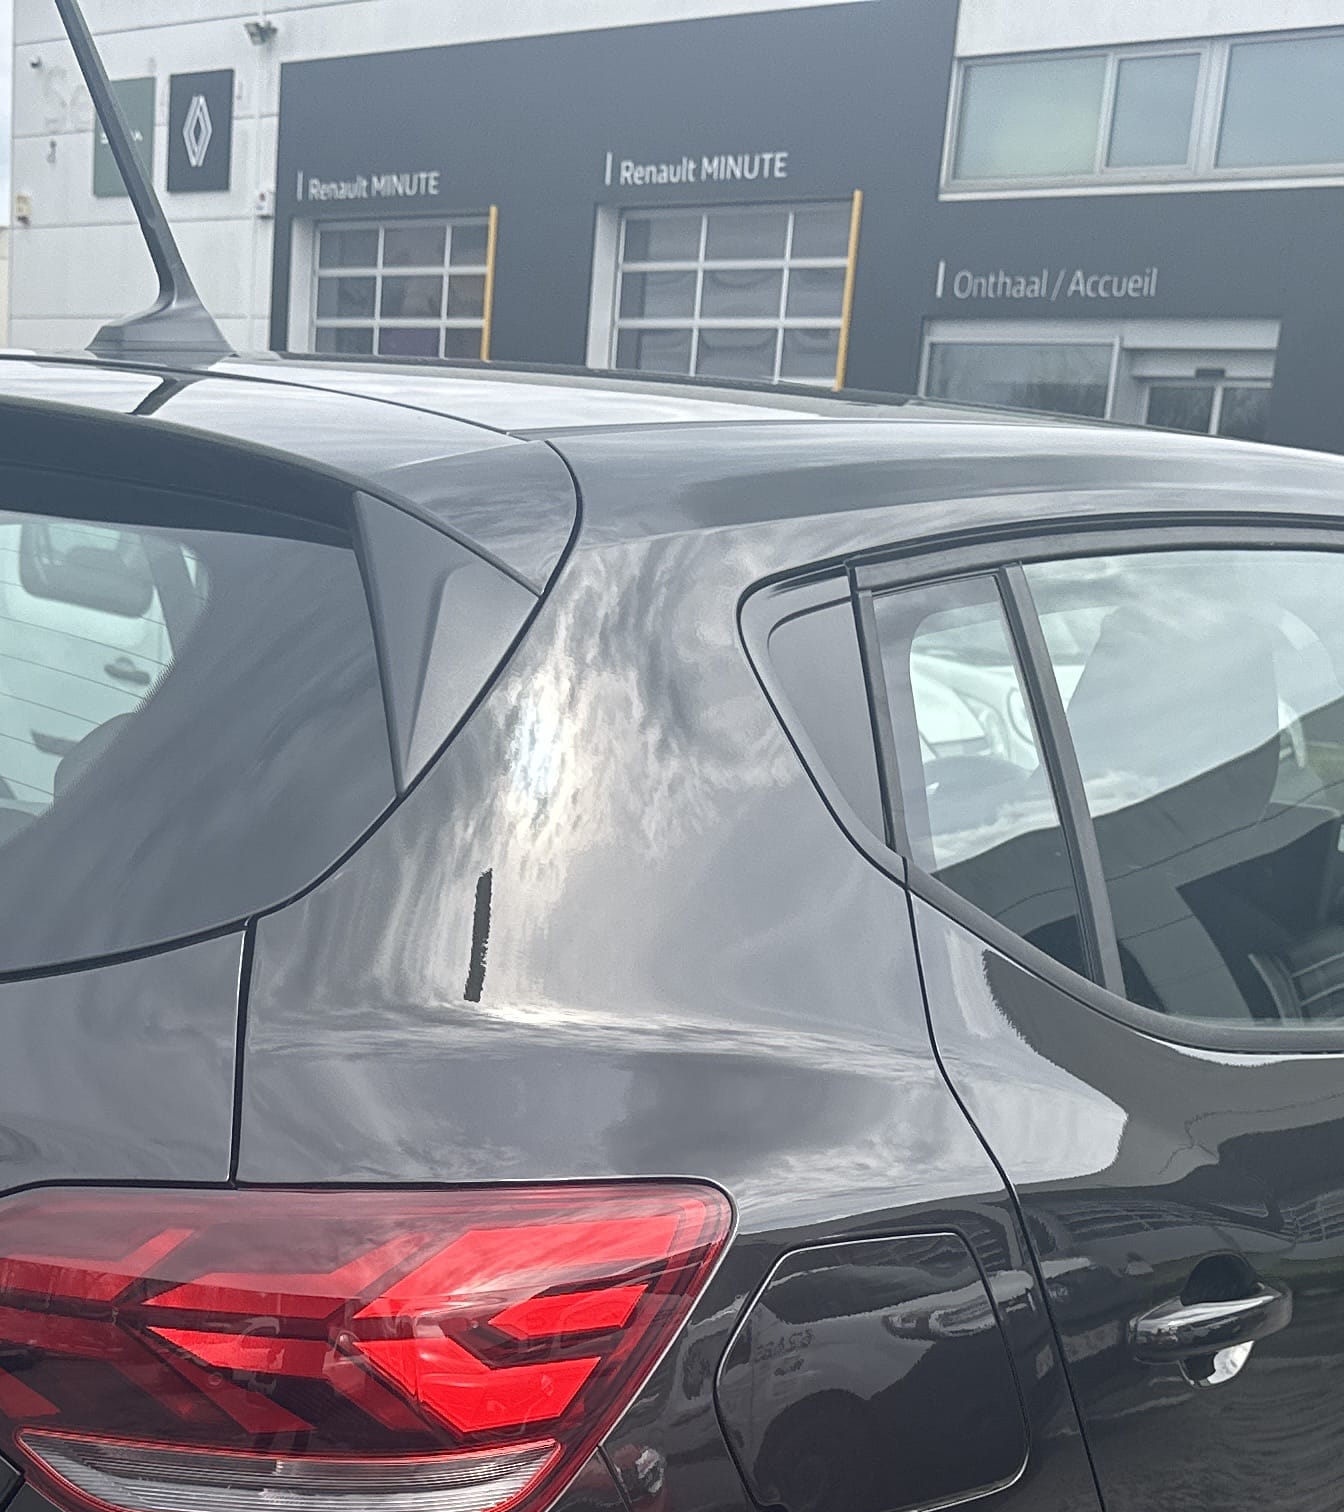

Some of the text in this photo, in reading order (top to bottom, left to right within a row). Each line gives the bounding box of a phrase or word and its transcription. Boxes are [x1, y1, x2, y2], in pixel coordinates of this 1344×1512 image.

[620, 152, 788, 185] Renault MINUTE
[309, 171, 439, 200] Renault MINUTE
[954, 268, 1048, 299] Onthaal
[1067, 267, 1158, 297] Accueil
